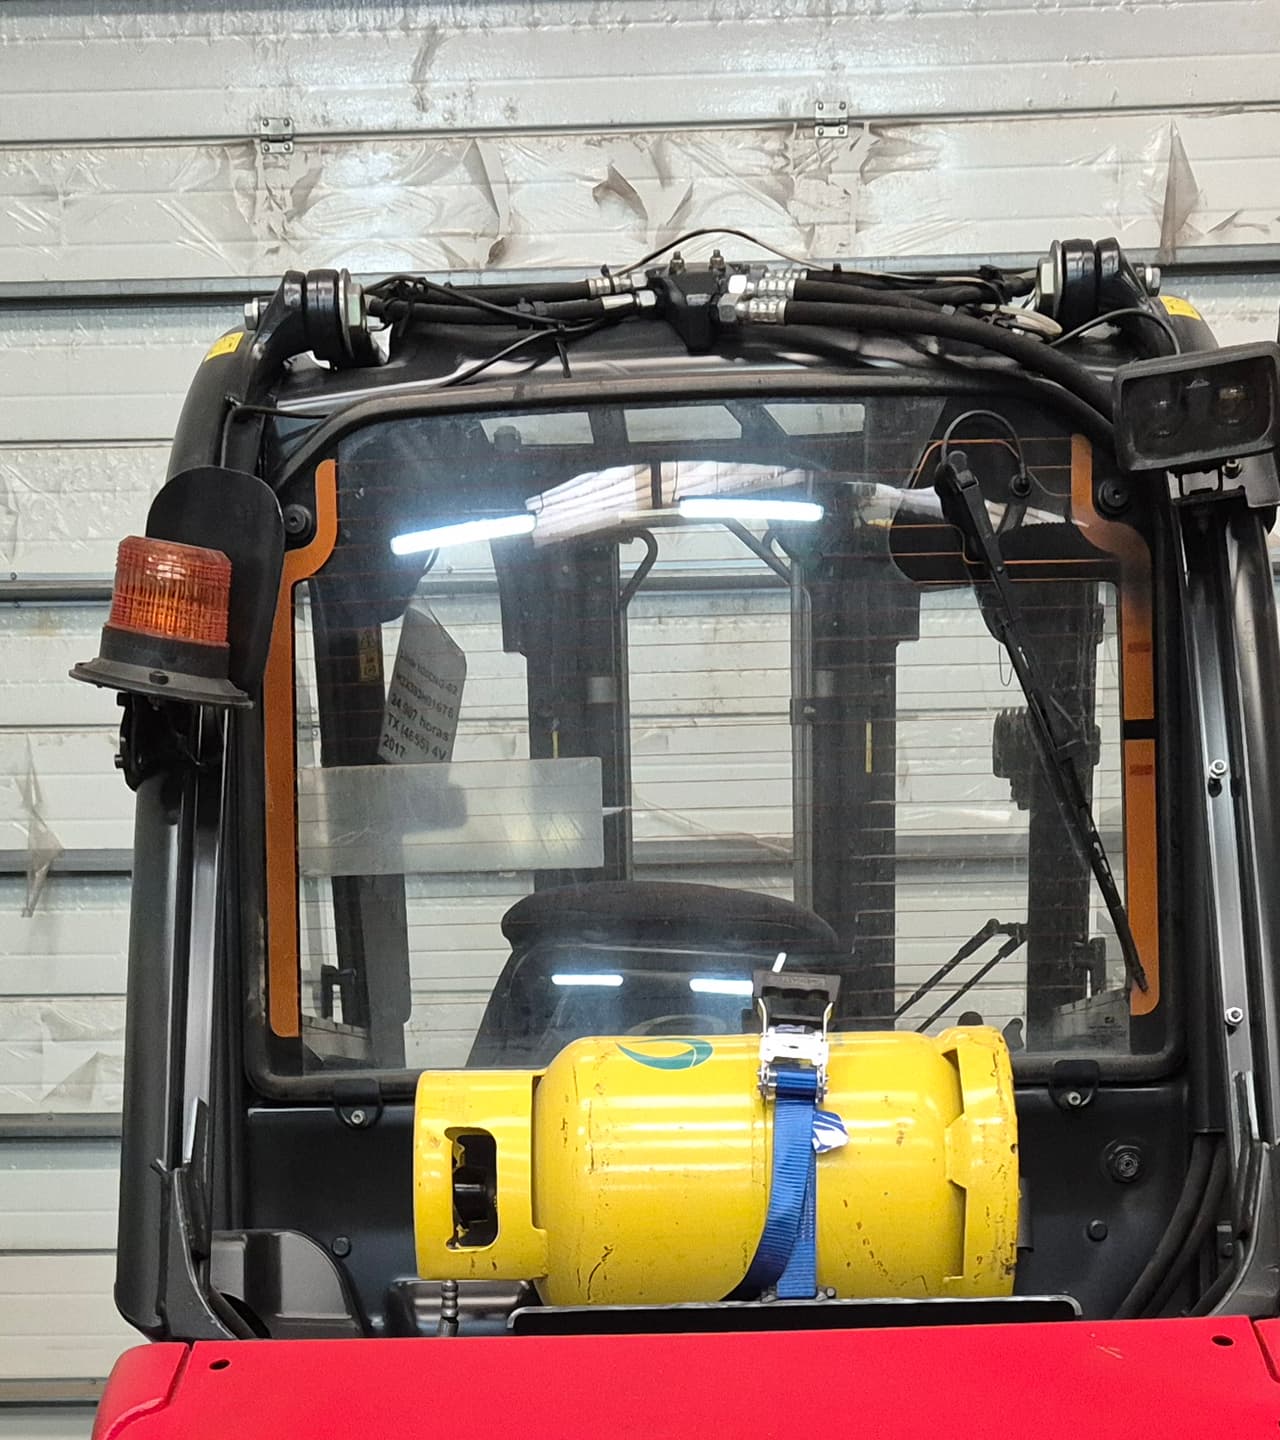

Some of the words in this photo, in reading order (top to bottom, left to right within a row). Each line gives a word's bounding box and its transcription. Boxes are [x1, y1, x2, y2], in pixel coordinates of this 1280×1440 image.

[388, 712, 400, 732] TX
[420, 714, 450, 743] horas
[383, 734, 407, 759] 2017
